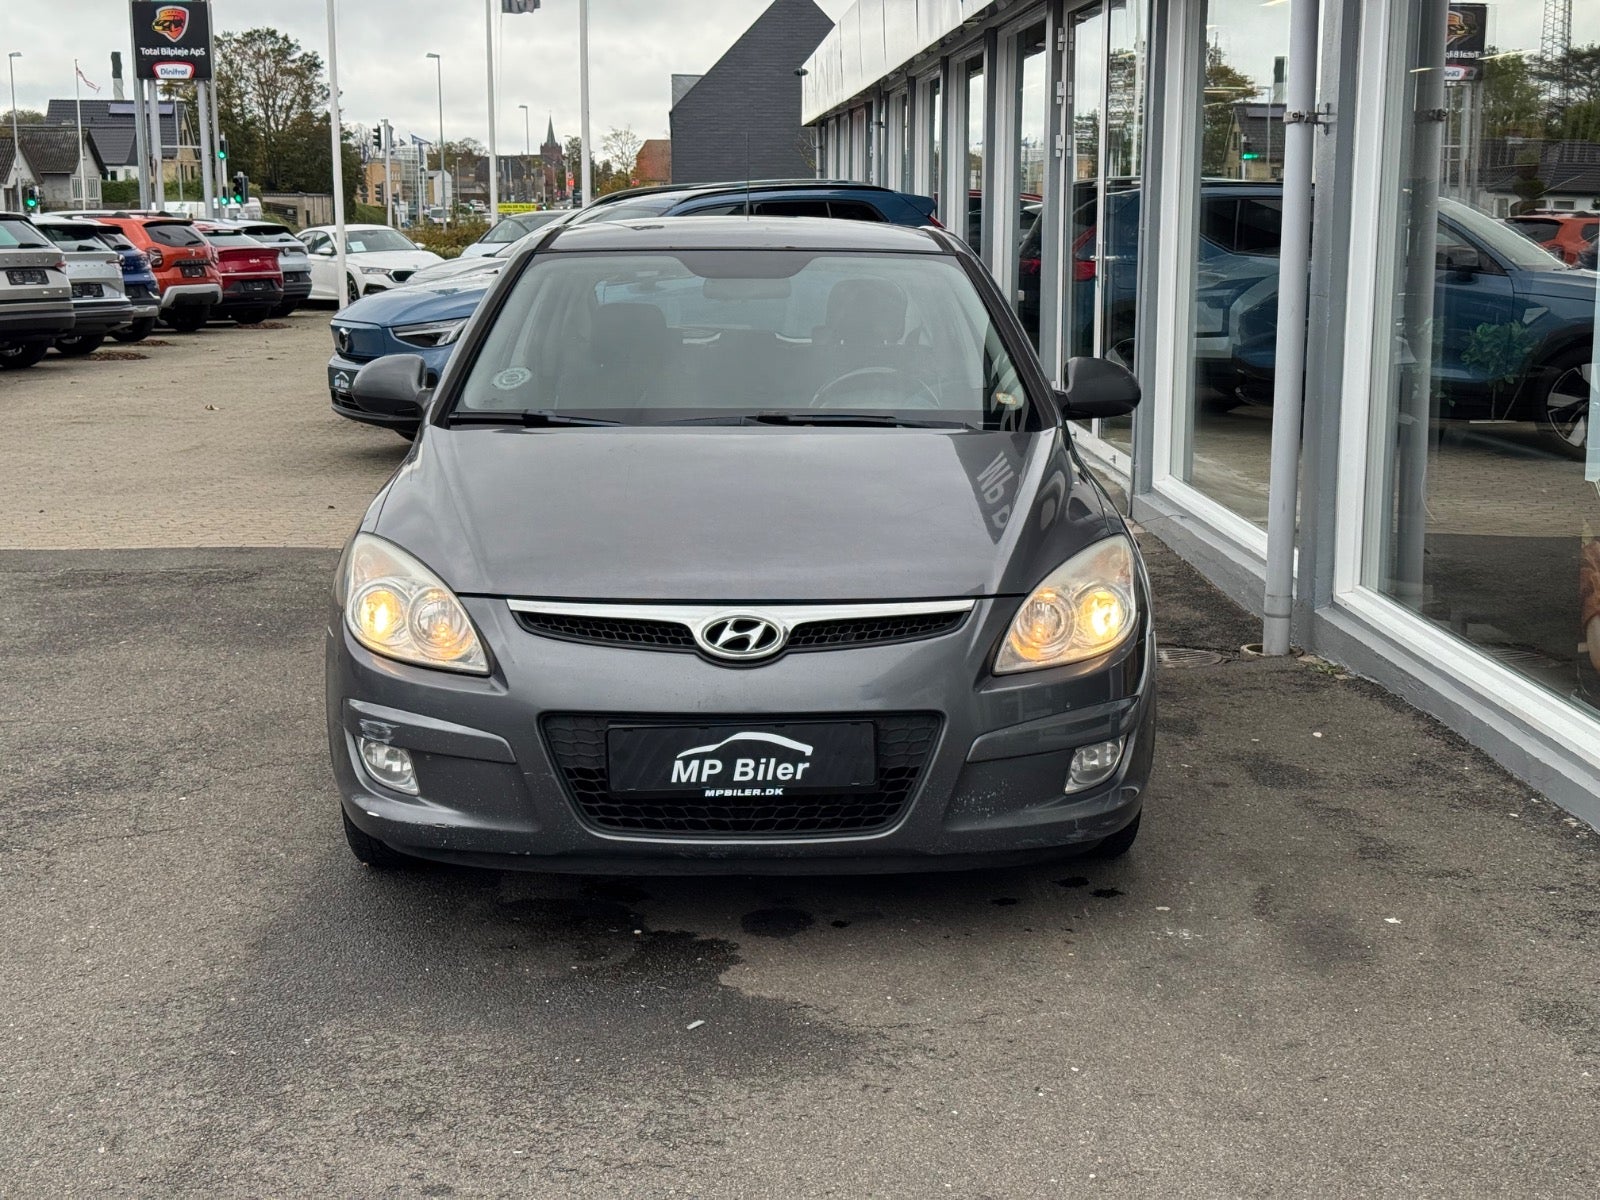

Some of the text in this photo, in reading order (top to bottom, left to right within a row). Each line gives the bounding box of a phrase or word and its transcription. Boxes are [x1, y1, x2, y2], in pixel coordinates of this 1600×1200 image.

[140, 47, 206, 57] Total Bilpleje ApS
[160, 68, 188, 76] Dinitrol
[670, 758, 810, 783] MP Biler
[704, 788, 784, 797] MPBILER.DK
